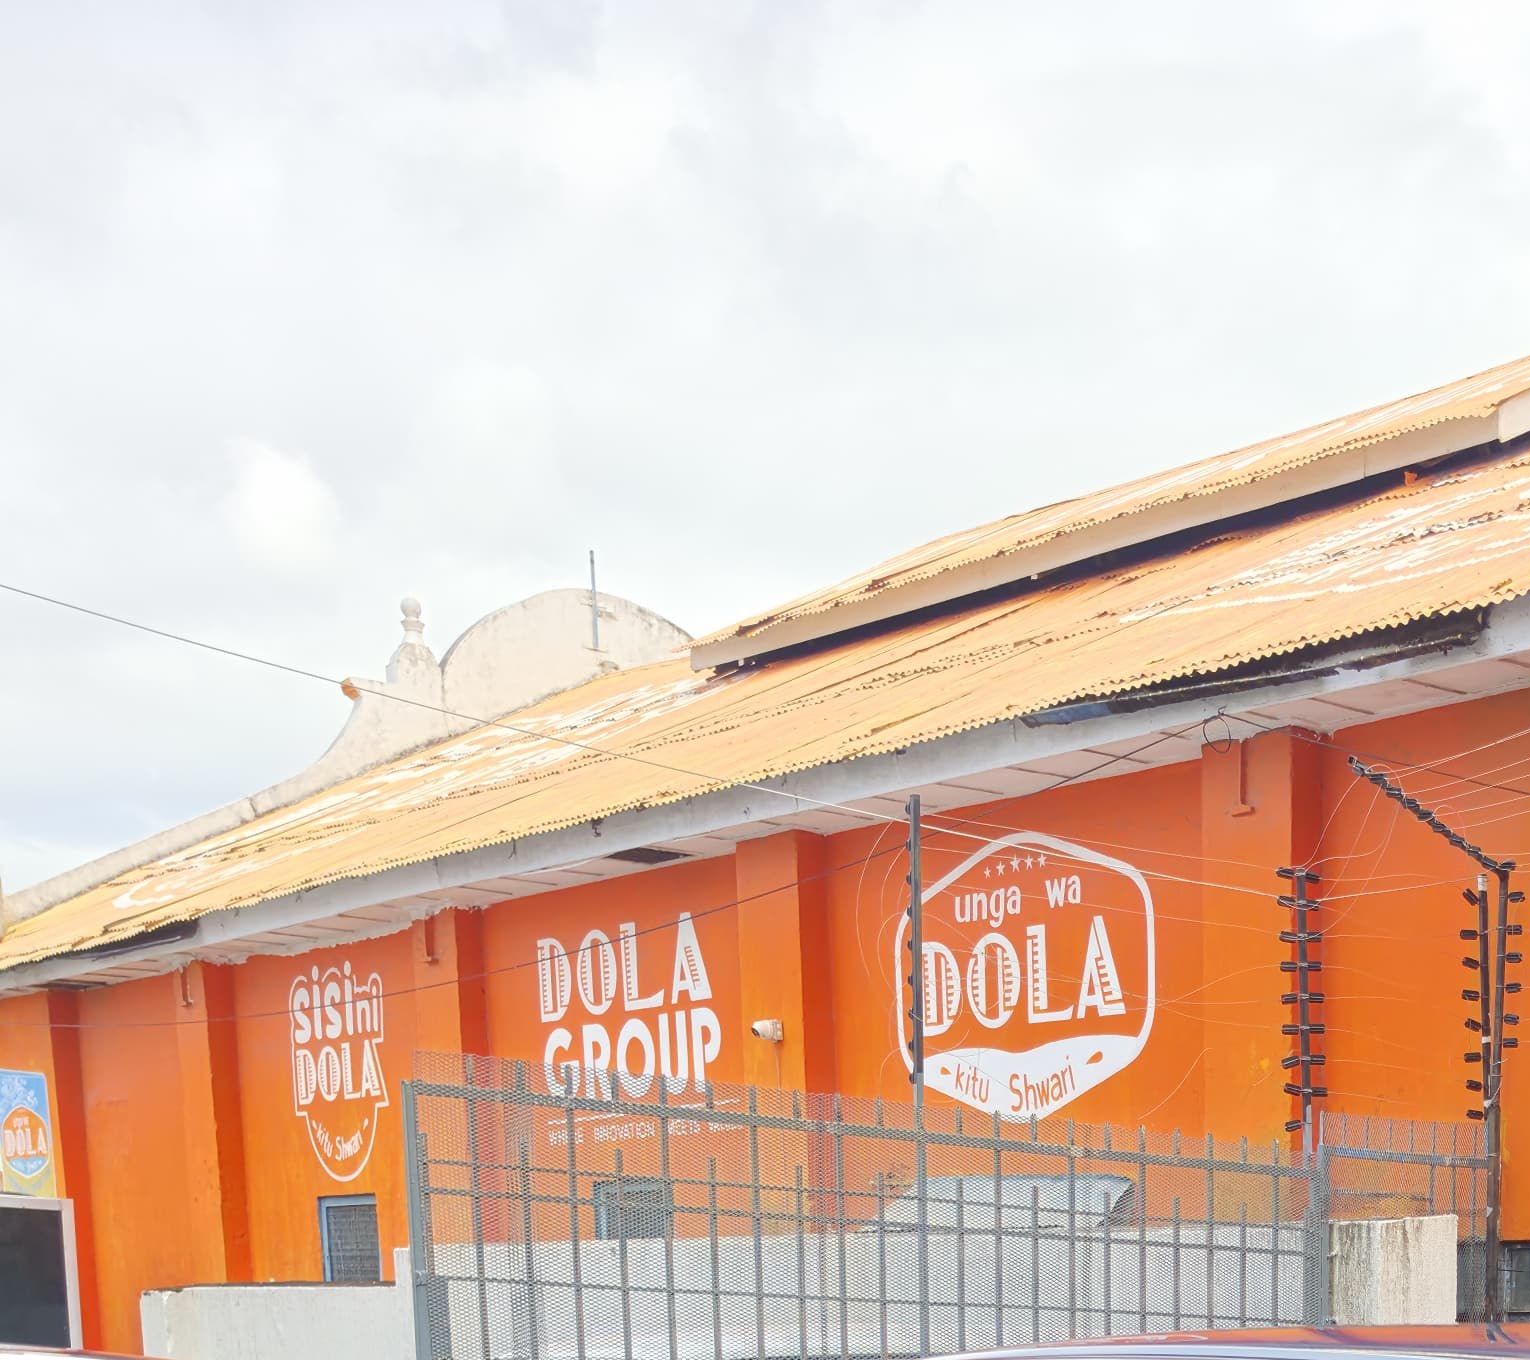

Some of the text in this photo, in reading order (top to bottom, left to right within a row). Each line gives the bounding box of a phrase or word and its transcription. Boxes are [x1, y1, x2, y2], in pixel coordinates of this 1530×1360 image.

[955, 874, 1082, 928] unga wa
[536, 911, 713, 1024] DOLA
[922, 914, 1127, 1038] DOLA
[295, 1039, 381, 1105] DOLA
[543, 1007, 722, 1101] GROUP
[954, 1055, 1077, 1113] kitu Shwari
[4, 1127, 49, 1157] DOLA
